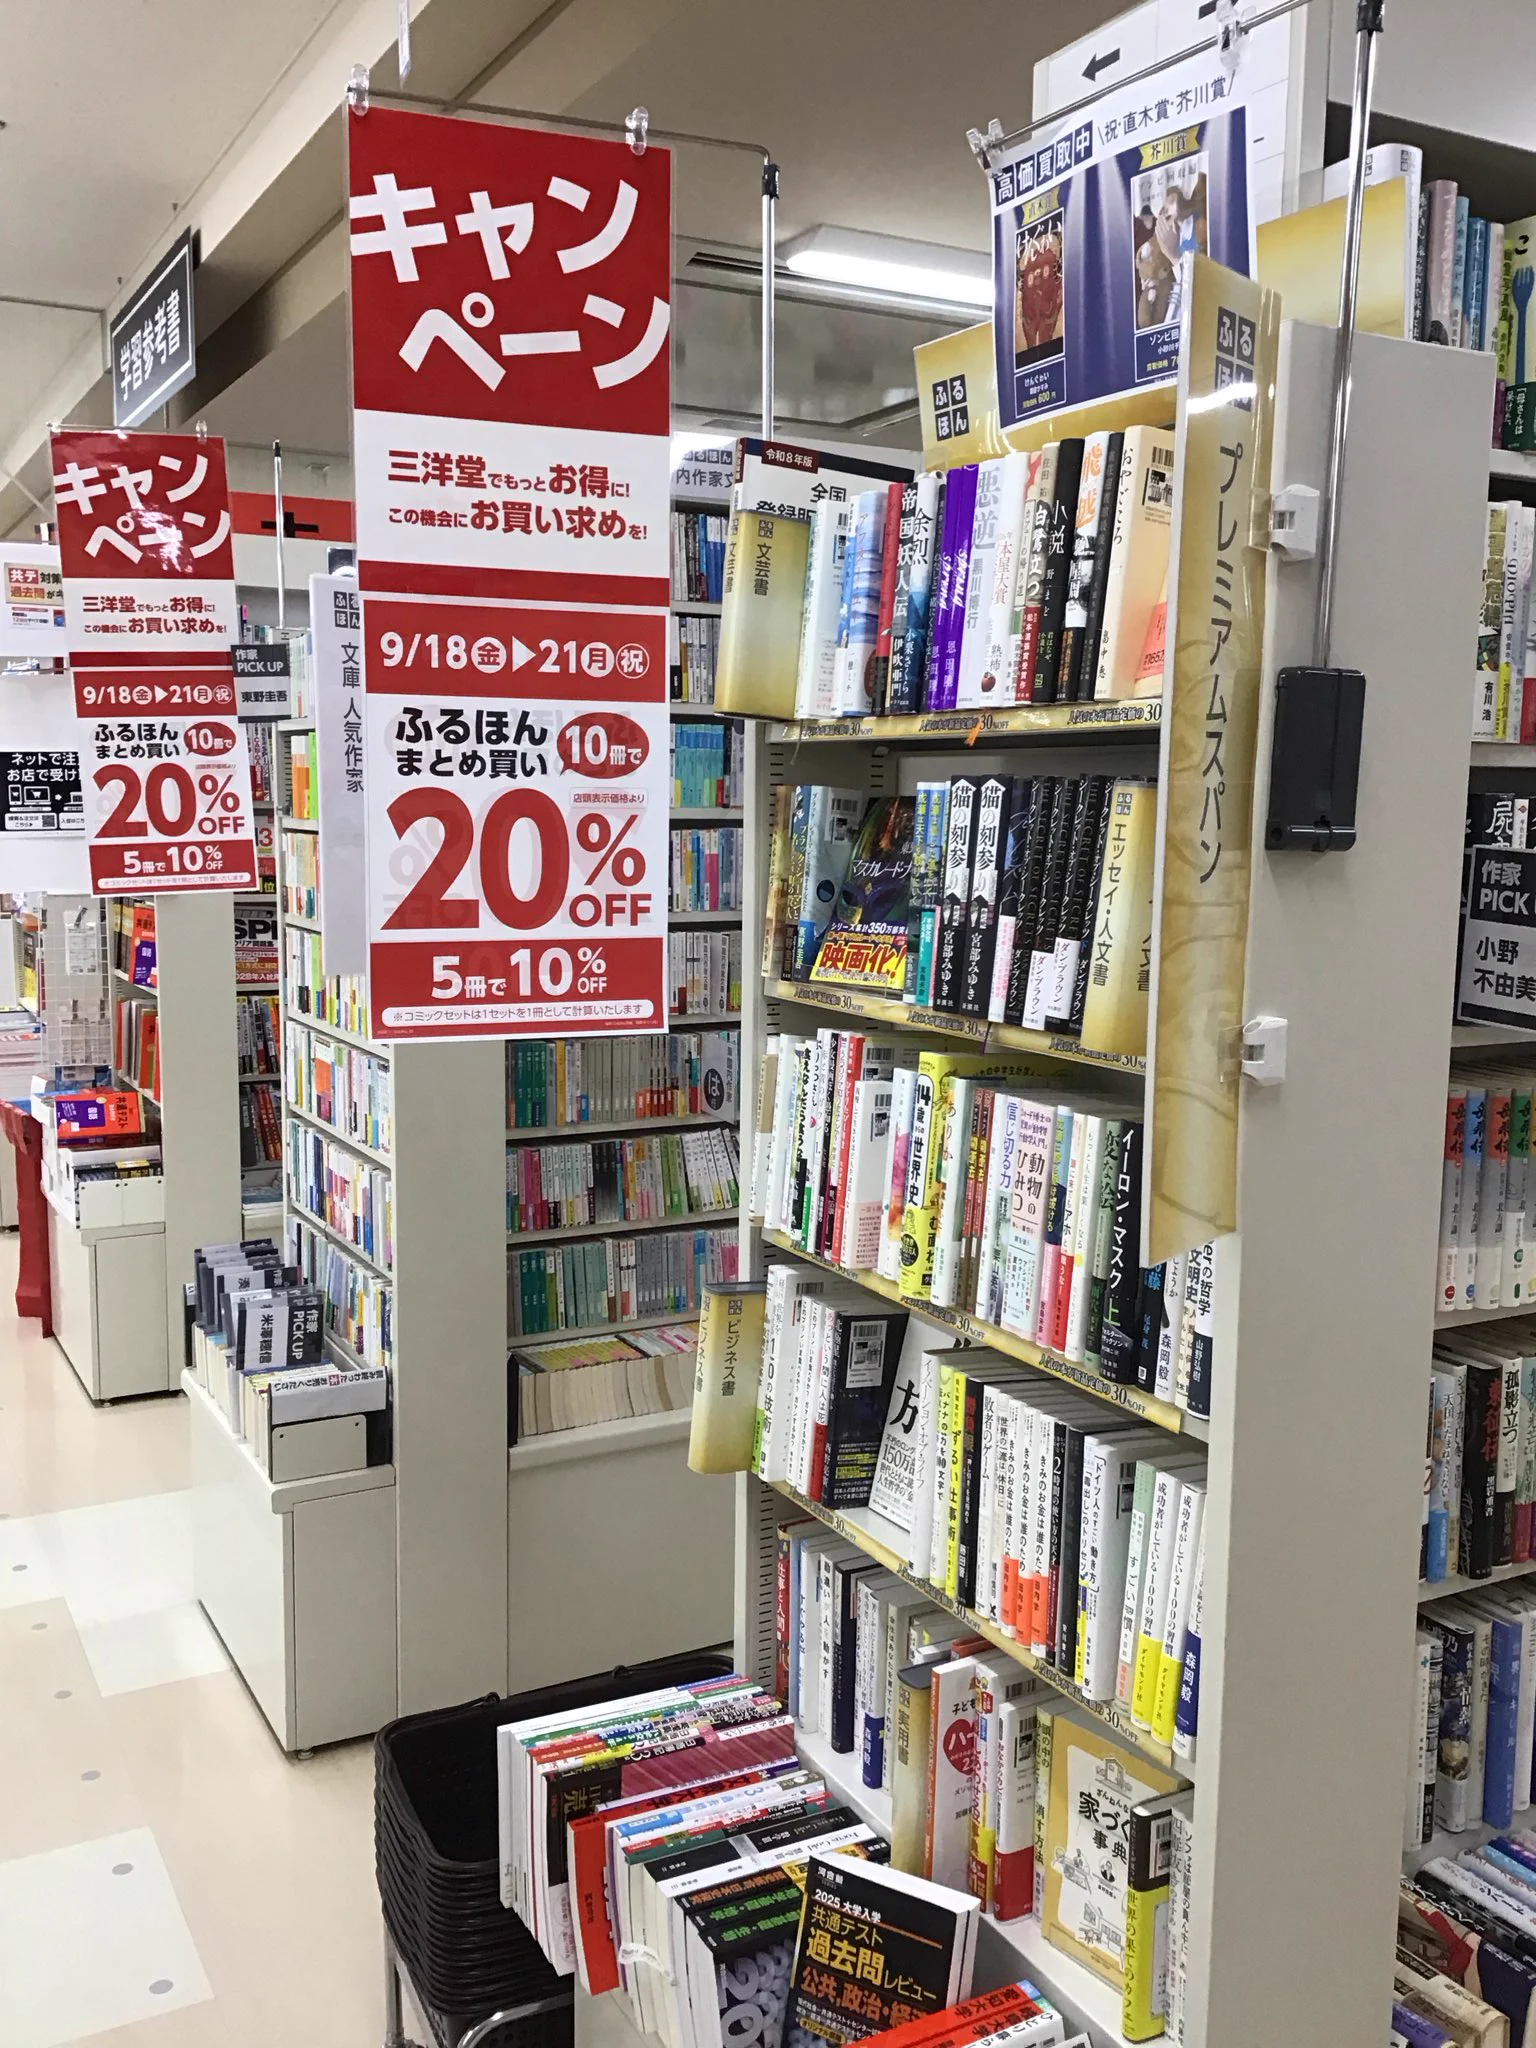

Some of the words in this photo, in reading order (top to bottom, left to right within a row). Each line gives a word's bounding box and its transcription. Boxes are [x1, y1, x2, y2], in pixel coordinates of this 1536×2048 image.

[995, 129, 1092, 201] 高価買取中
[1150, 134, 1187, 161] 芥川賞
[350, 173, 639, 283] キャン
[398, 292, 671, 392] ペーン
[765, 448, 814, 468] 令和8年版
[54, 454, 209, 516] キャン
[810, 483, 847, 503] 全国
[84, 509, 231, 564] ペーン
[911, 509, 934, 566] 余烈
[1048, 499, 1069, 557] 小説
[893, 488, 918, 618] 帝国妖人伝
[1028, 503, 1048, 597] 白鷺立つ
[753, 542, 773, 597] 文芸書
[237, 662, 265, 673] PICK
[267, 661, 284, 672] UP
[341, 642, 360, 689] 文庫
[1198, 443, 1244, 884] プレミアムスパン
[241, 690, 288, 703] 東野圭吾
[95, 722, 179, 742] ふるほん
[187, 729, 233, 751] 10冊で
[343, 698, 364, 793] 人気作家
[396, 707, 548, 747] ふるほん
[564, 724, 642, 765] 10冊で
[11, 753, 79, 765] ネットで注
[96, 743, 181, 760] まとめ買い
[396, 750, 548, 780] まとめ買い
[7, 768, 80, 781] お店で受け
[572, 793, 645, 804] 店頭表示価格より
[198, 816, 246, 835] OFF
[1481, 858, 1522, 887] 作家
[569, 893, 652, 928] OFF
[1092, 823, 1128, 987] エッセイ・人文書
[1478, 887, 1531, 916] PICK
[818, 940, 907, 979] 映画化!
[941, 931, 954, 997] 宮部みゆき
[967, 932, 983, 1001] 宮部みゆき
[1476, 936, 1519, 966] 小野
[1473, 966, 1536, 1002] 不由美
[1109, 1129, 1135, 1289] イーロン・マスク
[292, 1310, 304, 1345] PICK
[306, 1308, 319, 1334] 作家
[1103, 1297, 1122, 1327] 上
[292, 1346, 304, 1361] UP
[720, 1320, 741, 1397] ビジネス書
[982, 1396, 995, 1480] 敗者のゲーム
[1181, 1650, 1197, 1704] 森岡毅
[1091, 1828, 1128, 1866] 事典
[815, 1887, 841, 1909] 2025
[841, 1900, 882, 1924] 大学入学
[811, 1905, 884, 1947] 共通テスト
